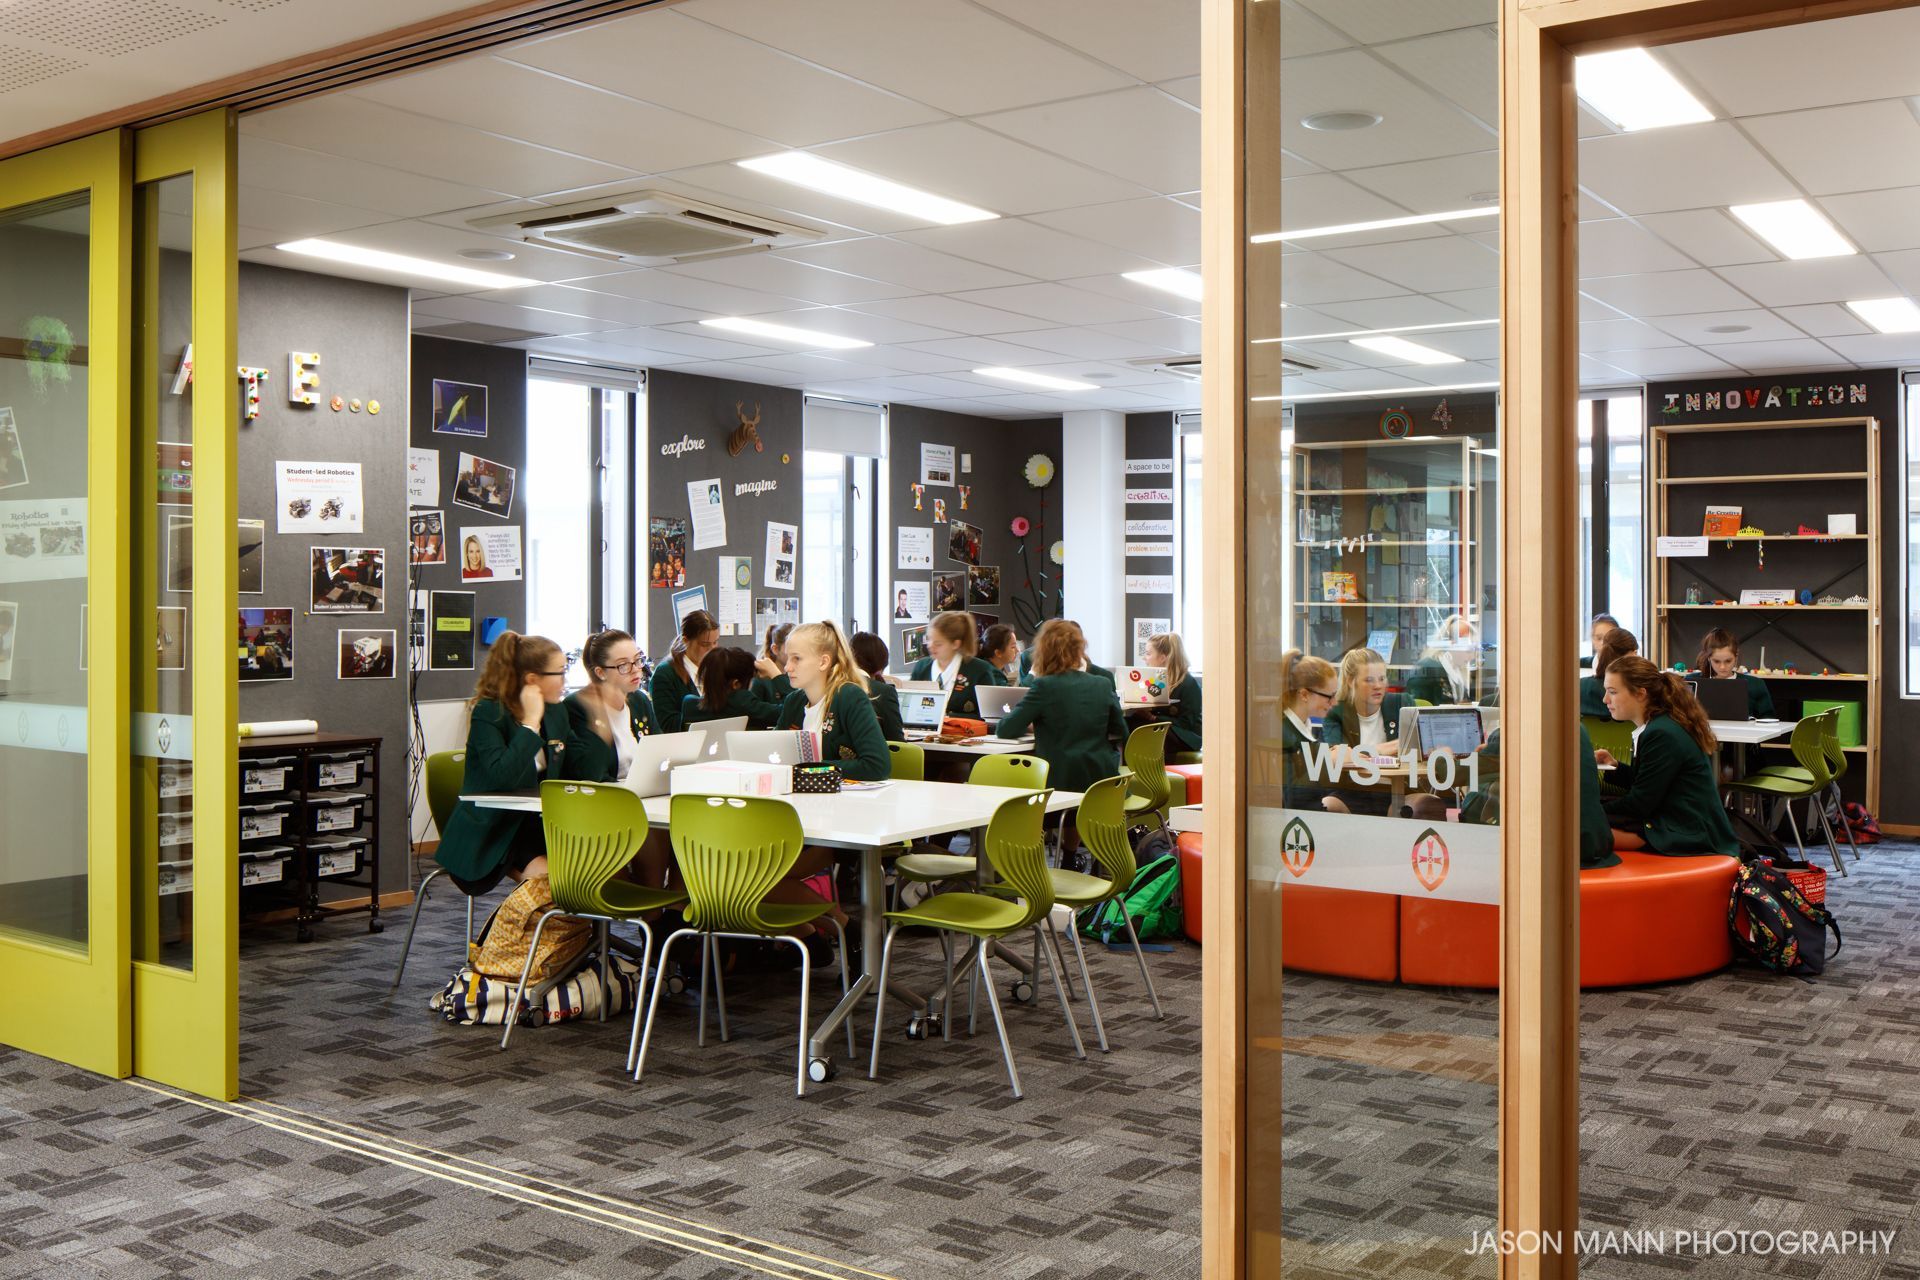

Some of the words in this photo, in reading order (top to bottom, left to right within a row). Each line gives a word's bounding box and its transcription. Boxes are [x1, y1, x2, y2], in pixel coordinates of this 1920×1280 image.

[1663, 384, 1867, 415] INNOVATION
[661, 434, 706, 458] explore
[735, 479, 777, 496] imagine
[1301, 741, 1382, 786] WS
[1401, 748, 1479, 792] 101
[554, 1006, 580, 1019] ROAD
